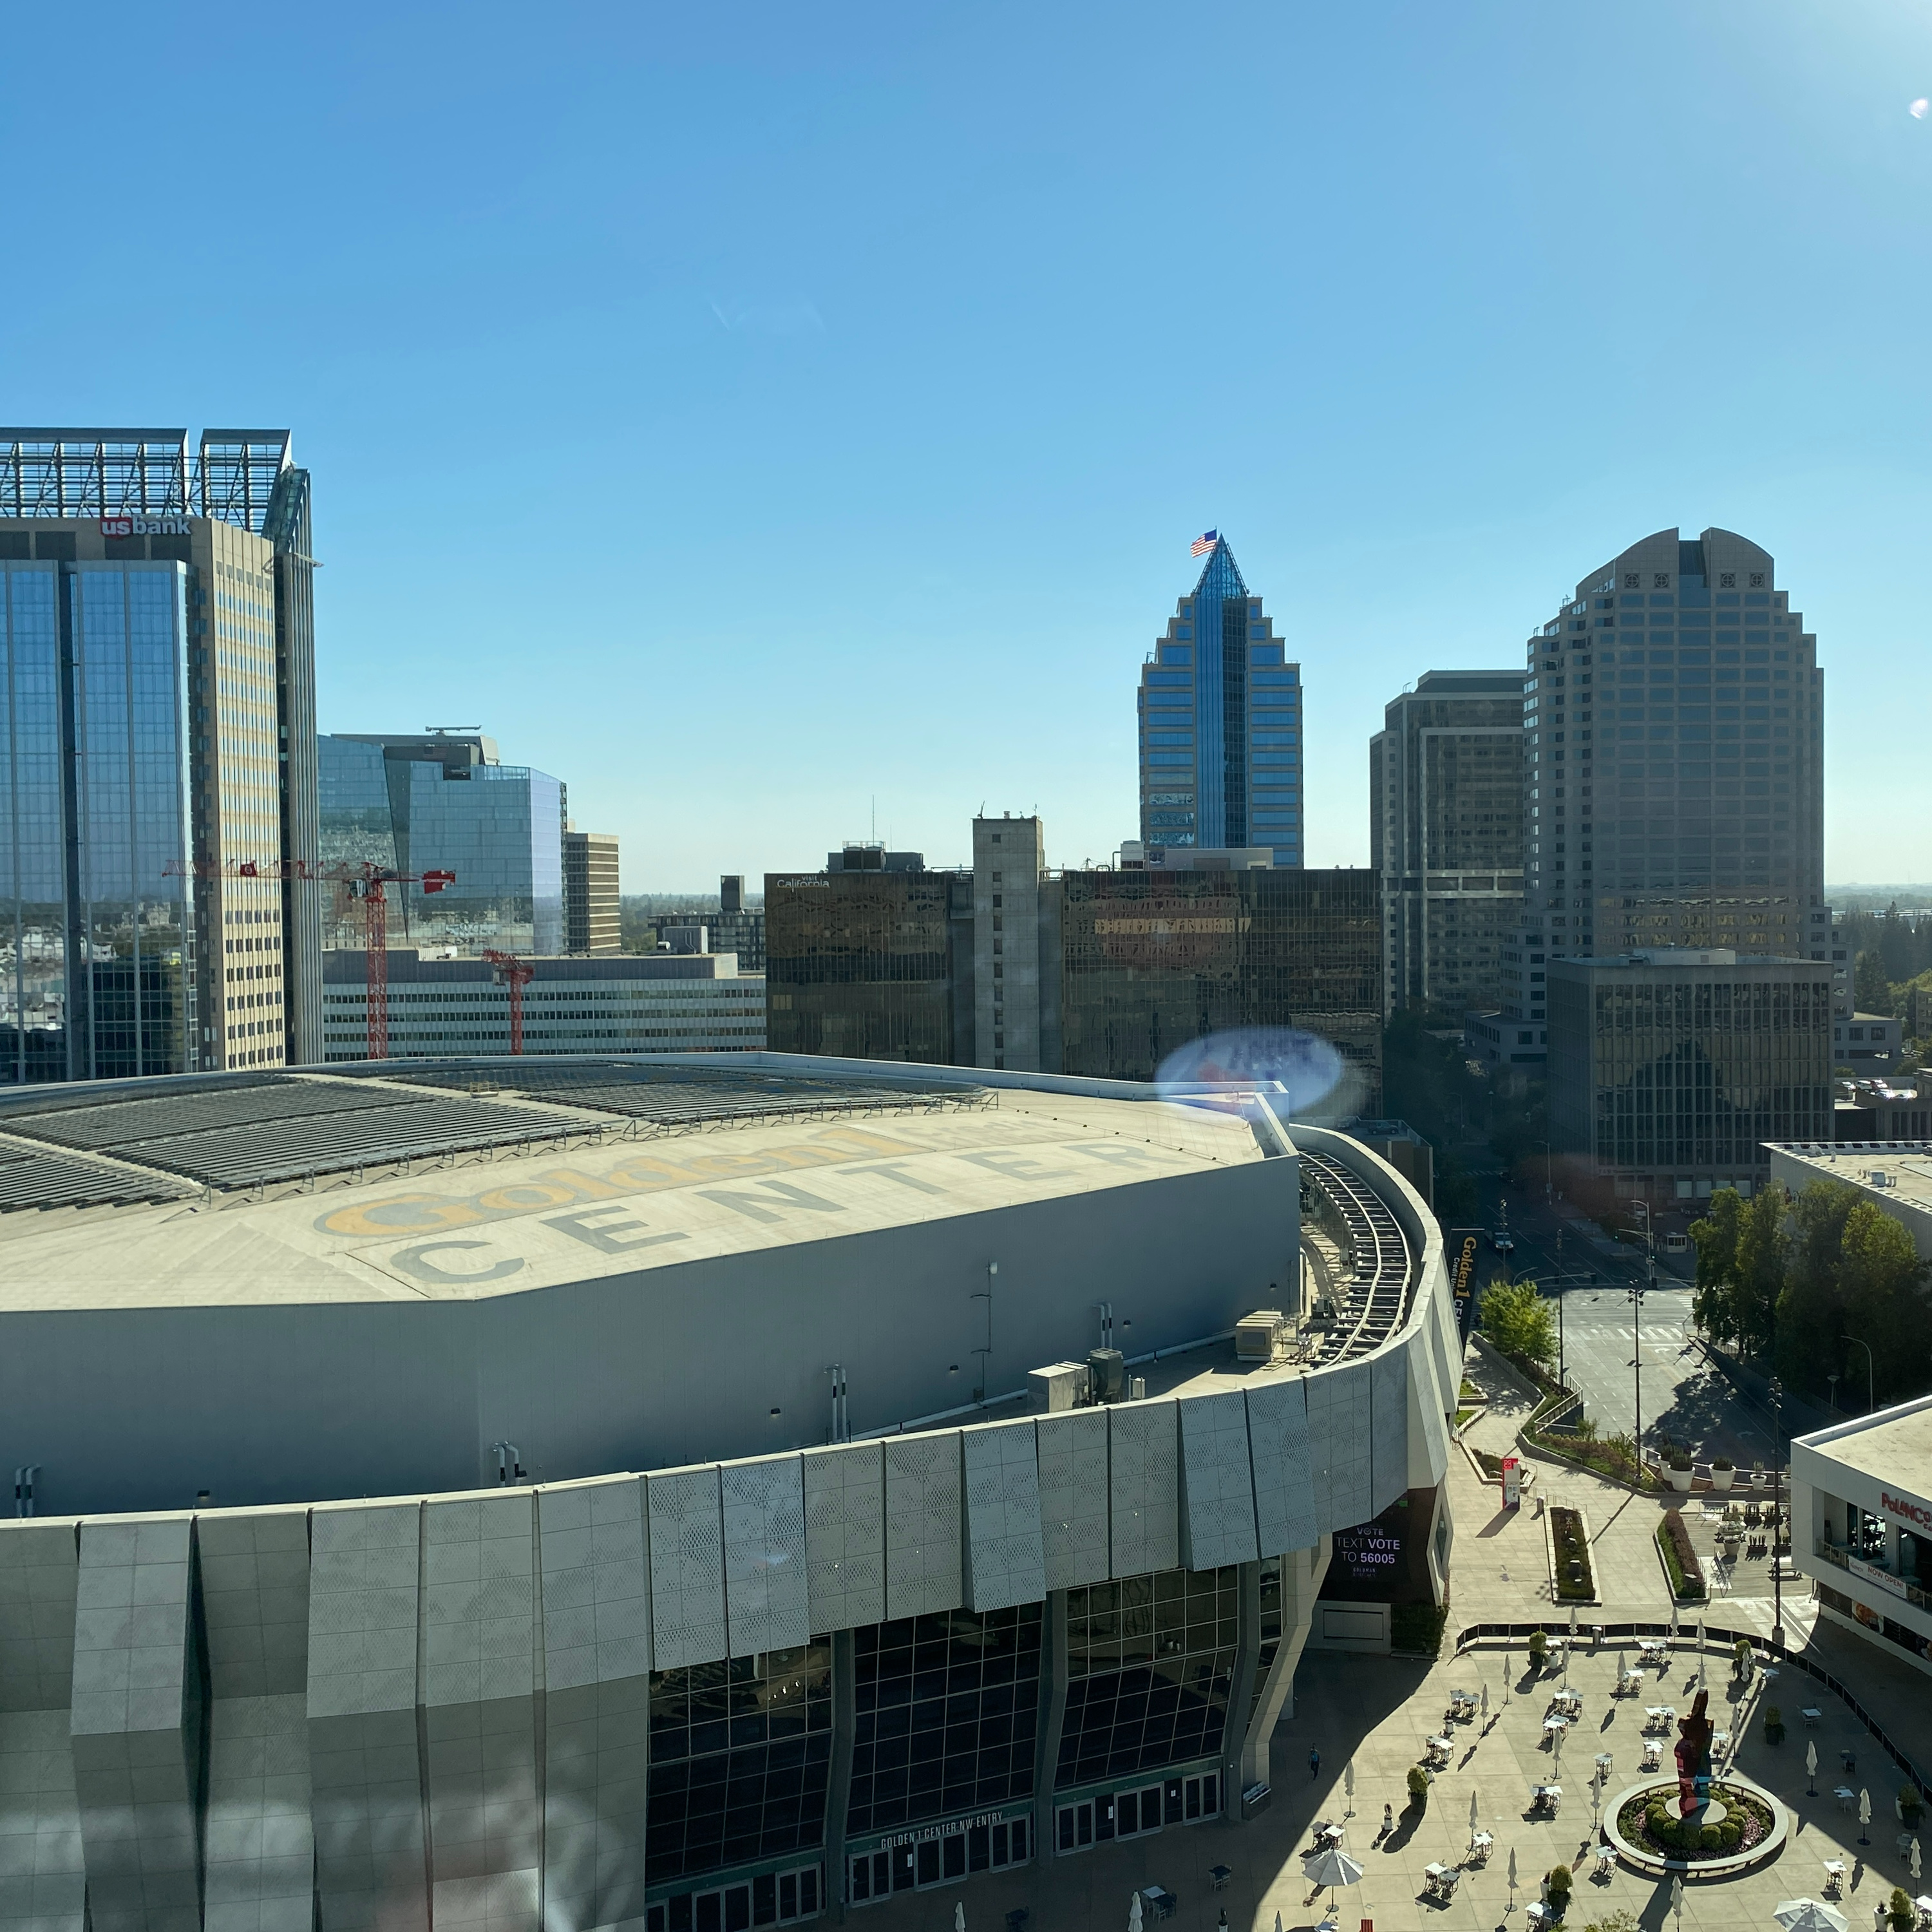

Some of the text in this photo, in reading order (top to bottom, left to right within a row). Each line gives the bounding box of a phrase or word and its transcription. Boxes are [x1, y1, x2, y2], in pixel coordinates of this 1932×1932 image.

[777, 878, 829, 893] California
[389, 1143, 1190, 1284] CENTER
[1452, 1257, 1460, 1278] Credit
[1335, 1537, 1400, 1550] TEXT VOTE
[1341, 1551, 1395, 1564] TO 56005
[1868, 1566, 1883, 1578] NOW
[881, 1811, 1003, 1850] GOLDEN 1 CENTER NW ENTRY
